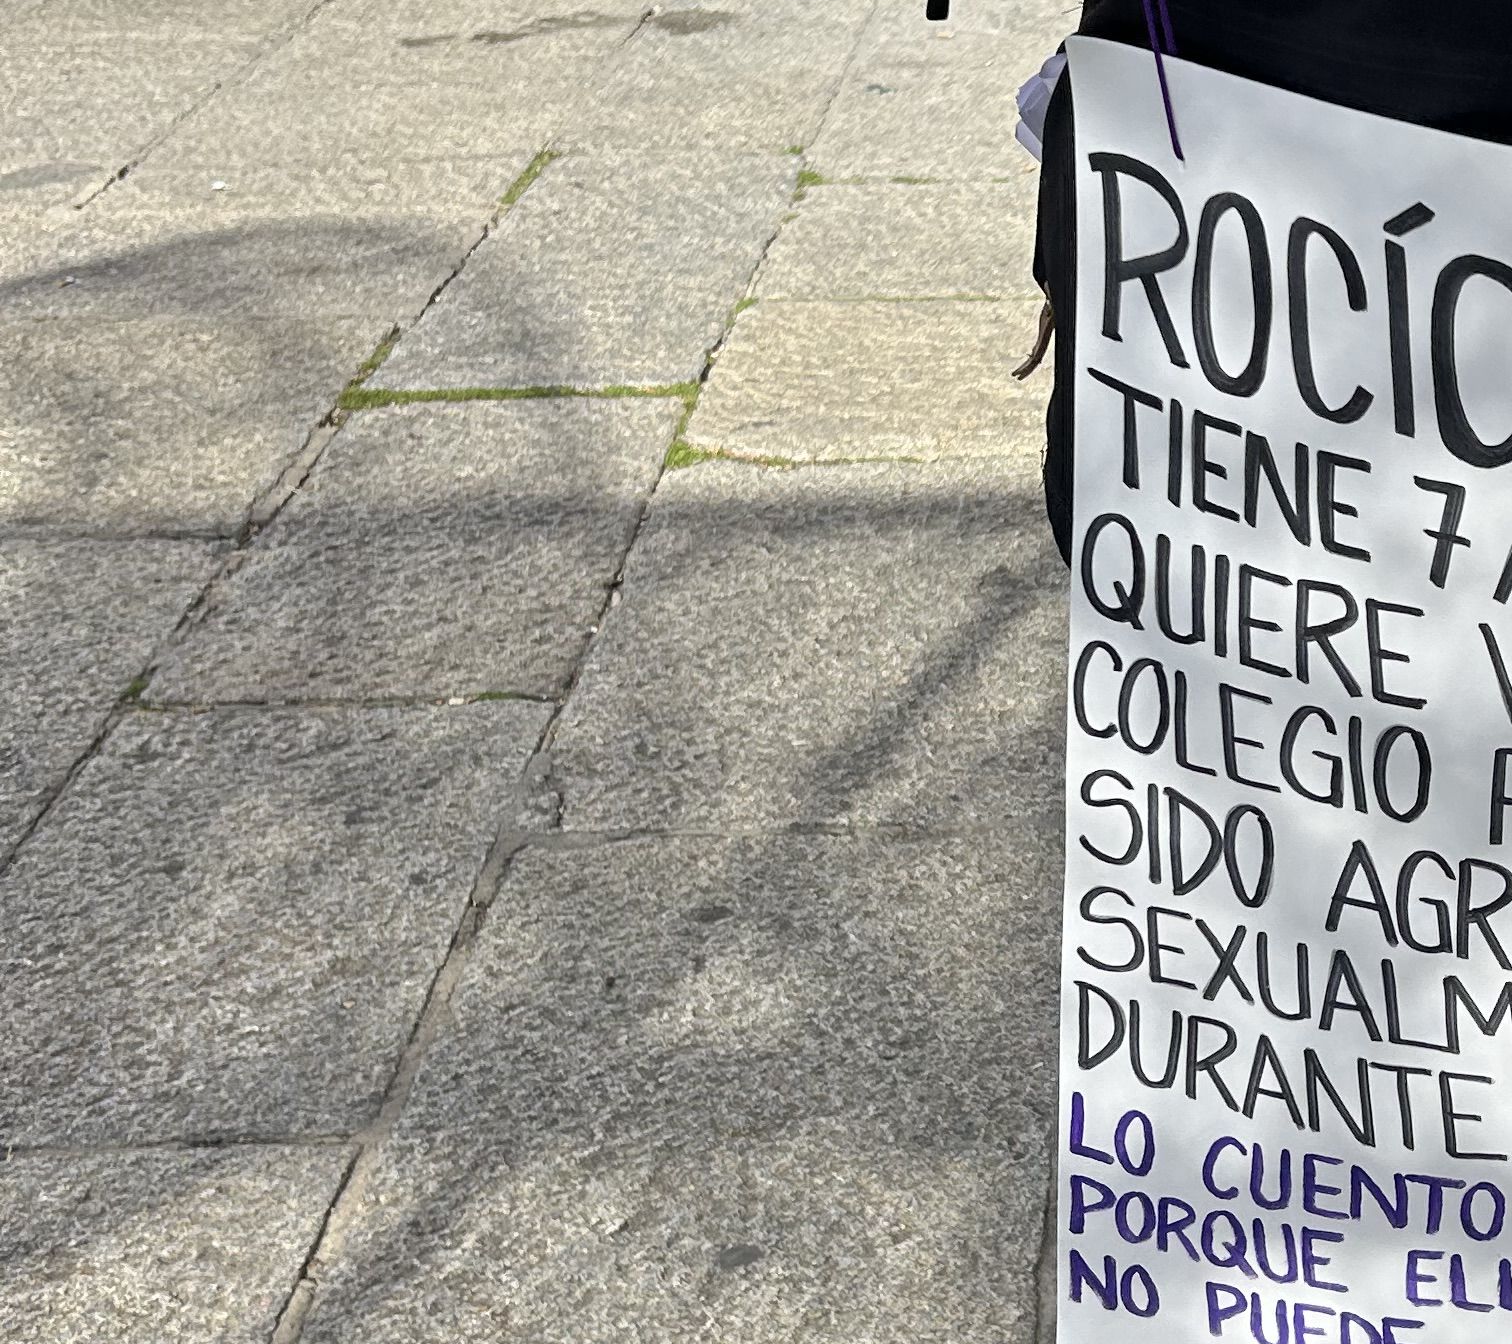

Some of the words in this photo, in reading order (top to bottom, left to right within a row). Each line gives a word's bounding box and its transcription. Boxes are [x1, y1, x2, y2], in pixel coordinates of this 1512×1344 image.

[1087, 367, 1371, 562] TIENE
[1414, 476, 1471, 589] 7
[1081, 513, 1428, 709] QUIERE
[1073, 640, 1431, 823] COLEGIO
[1079, 769, 1275, 908] SIDO
[1073, 981, 1508, 1161] DURANTE
[1068, 1174, 1349, 1294] PORQUE
[1070, 1092, 1154, 1177] LO
[1202, 1136, 1505, 1242] CUENTO
[1068, 1249, 1160, 1318] NO
